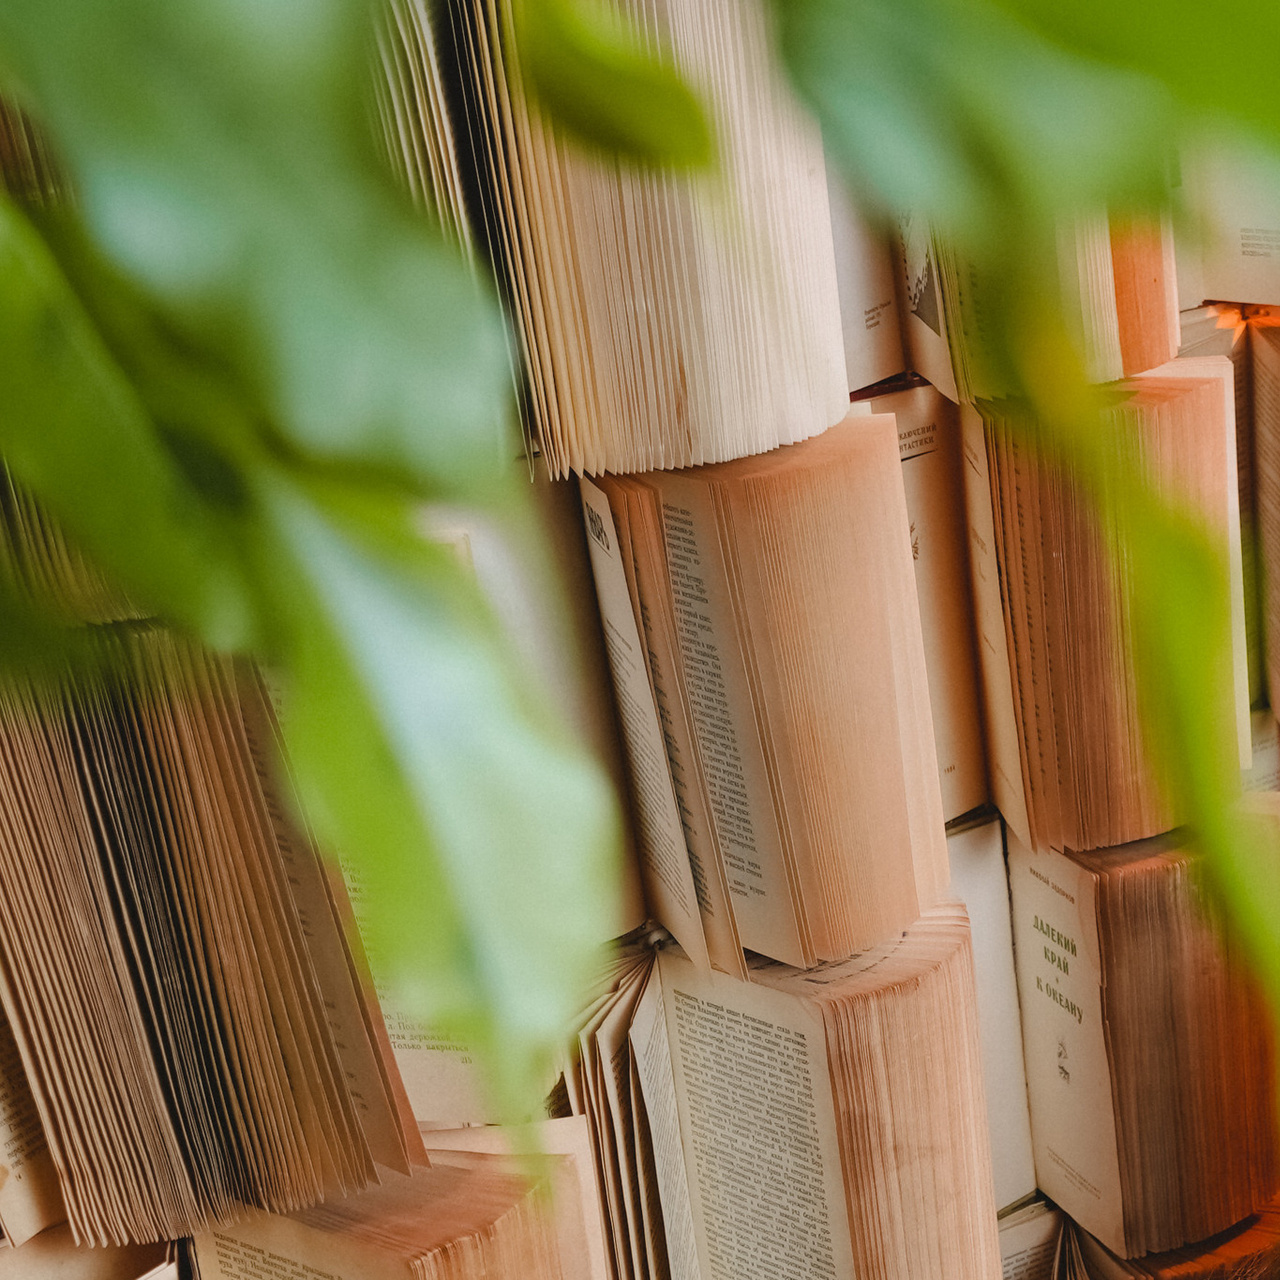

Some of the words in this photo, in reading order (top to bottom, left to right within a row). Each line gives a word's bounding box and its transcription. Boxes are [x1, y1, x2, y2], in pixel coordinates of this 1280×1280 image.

[1032, 914, 1078, 958] ДАЛЕКИЙ
[1043, 945, 1070, 976] КРАЙ
[1036, 975, 1044, 993] К
[1045, 980, 1084, 1026] ОКЕАНУ
